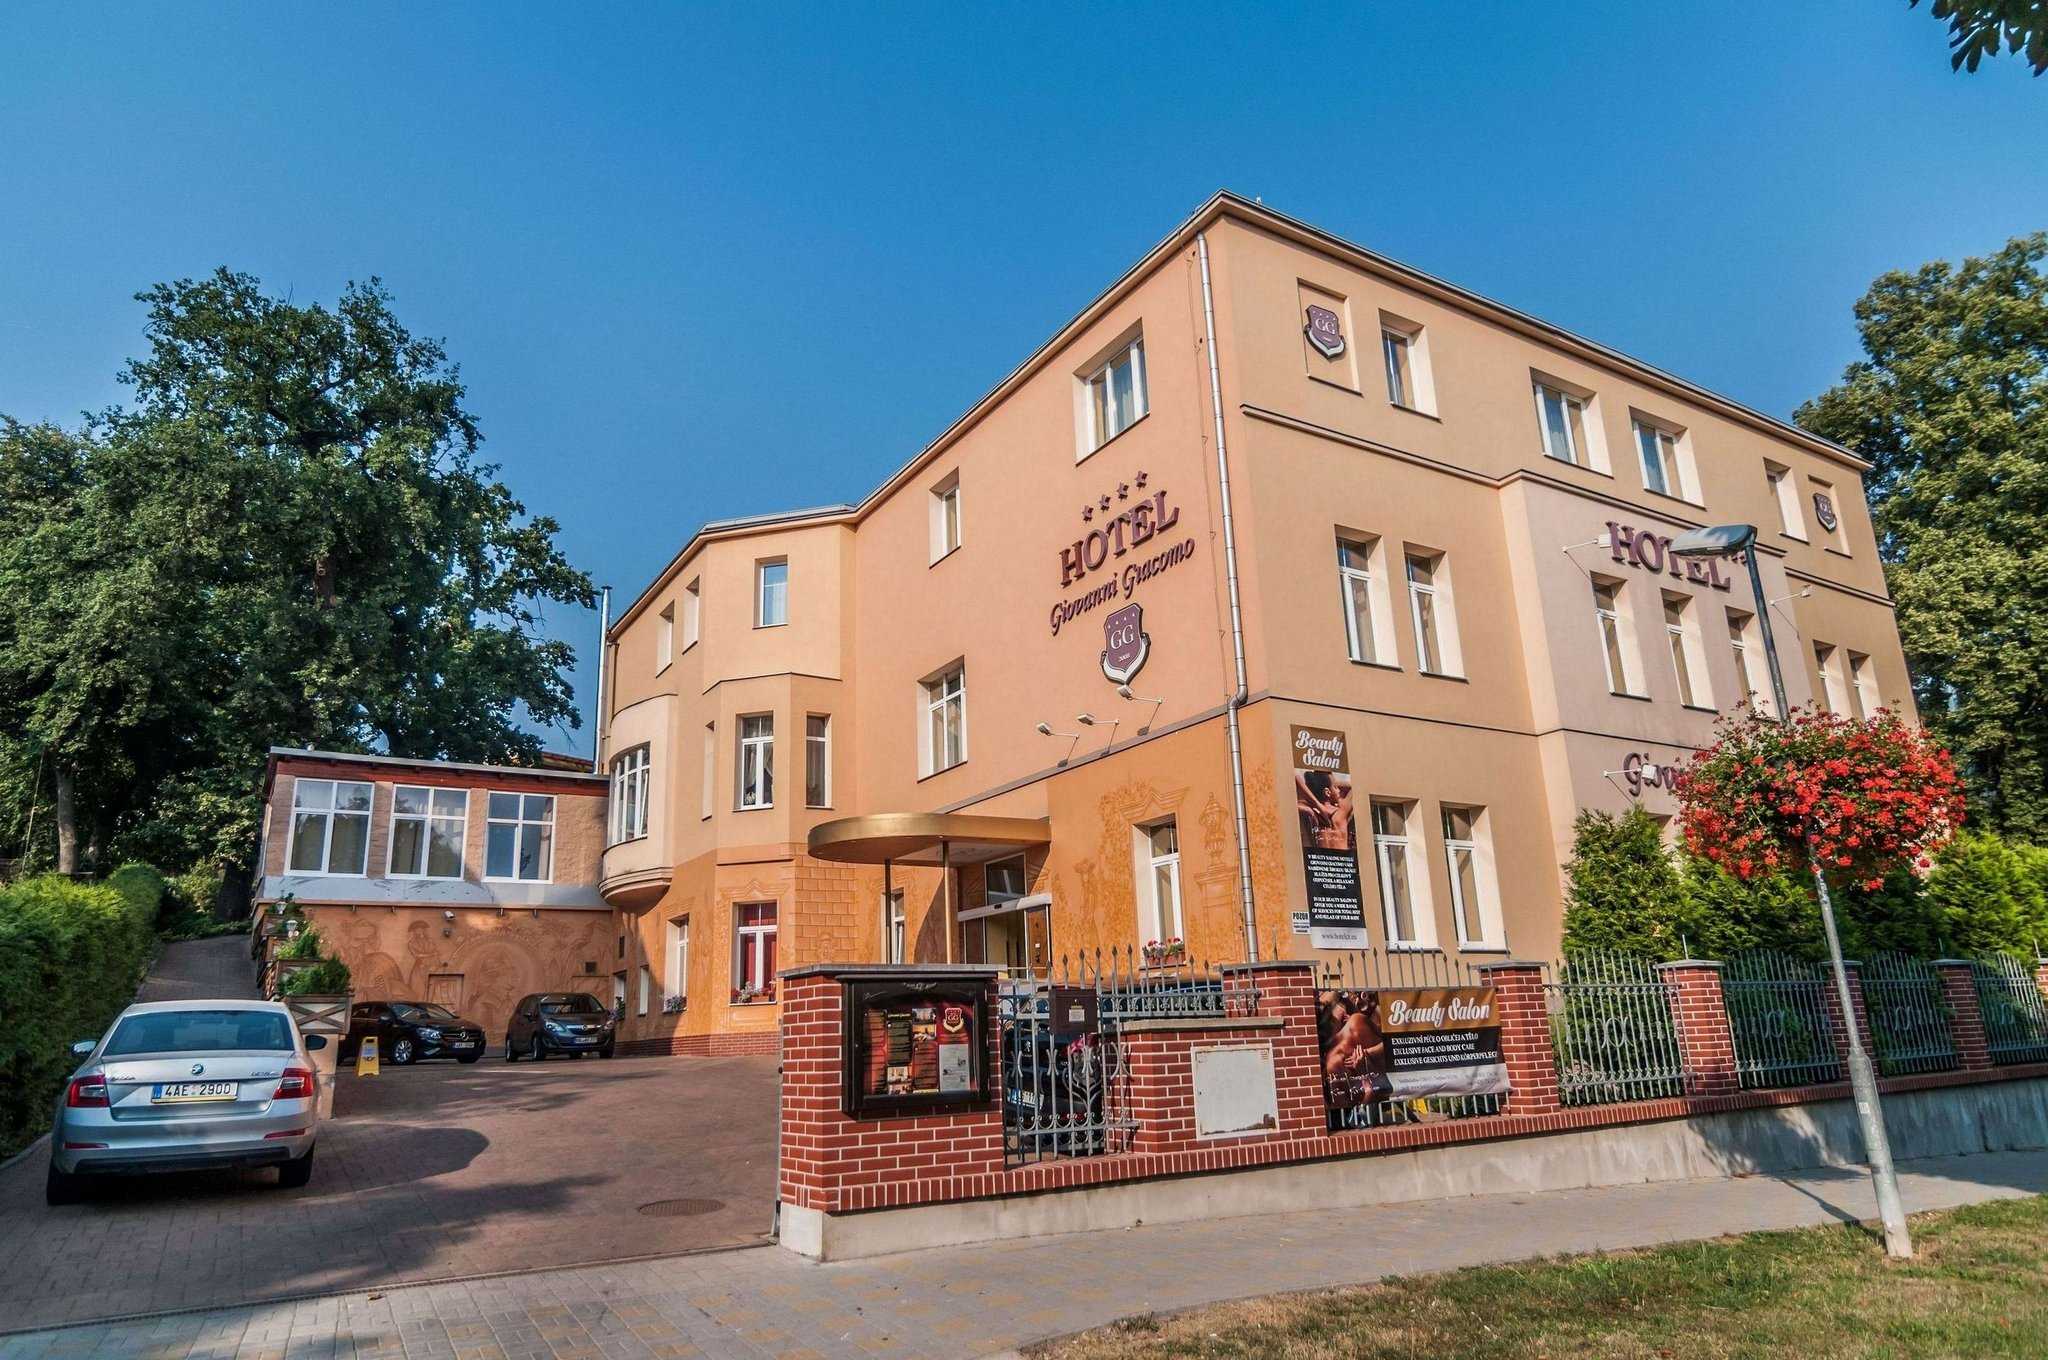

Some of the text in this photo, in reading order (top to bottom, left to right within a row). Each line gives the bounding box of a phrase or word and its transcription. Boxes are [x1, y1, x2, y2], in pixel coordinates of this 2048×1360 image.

[1059, 490, 1180, 589] HOTEL
[1605, 521, 1731, 593] HOTEL
[1050, 538, 1196, 637] Giovanni Giacomo
[1110, 624, 1134, 650] GG
[1295, 730, 1344, 756] Beauty
[1302, 748, 1340, 769] Salon
[1388, 997, 1490, 1027] Beauty Salon
[165, 1083, 231, 1097] 4AE 2900
